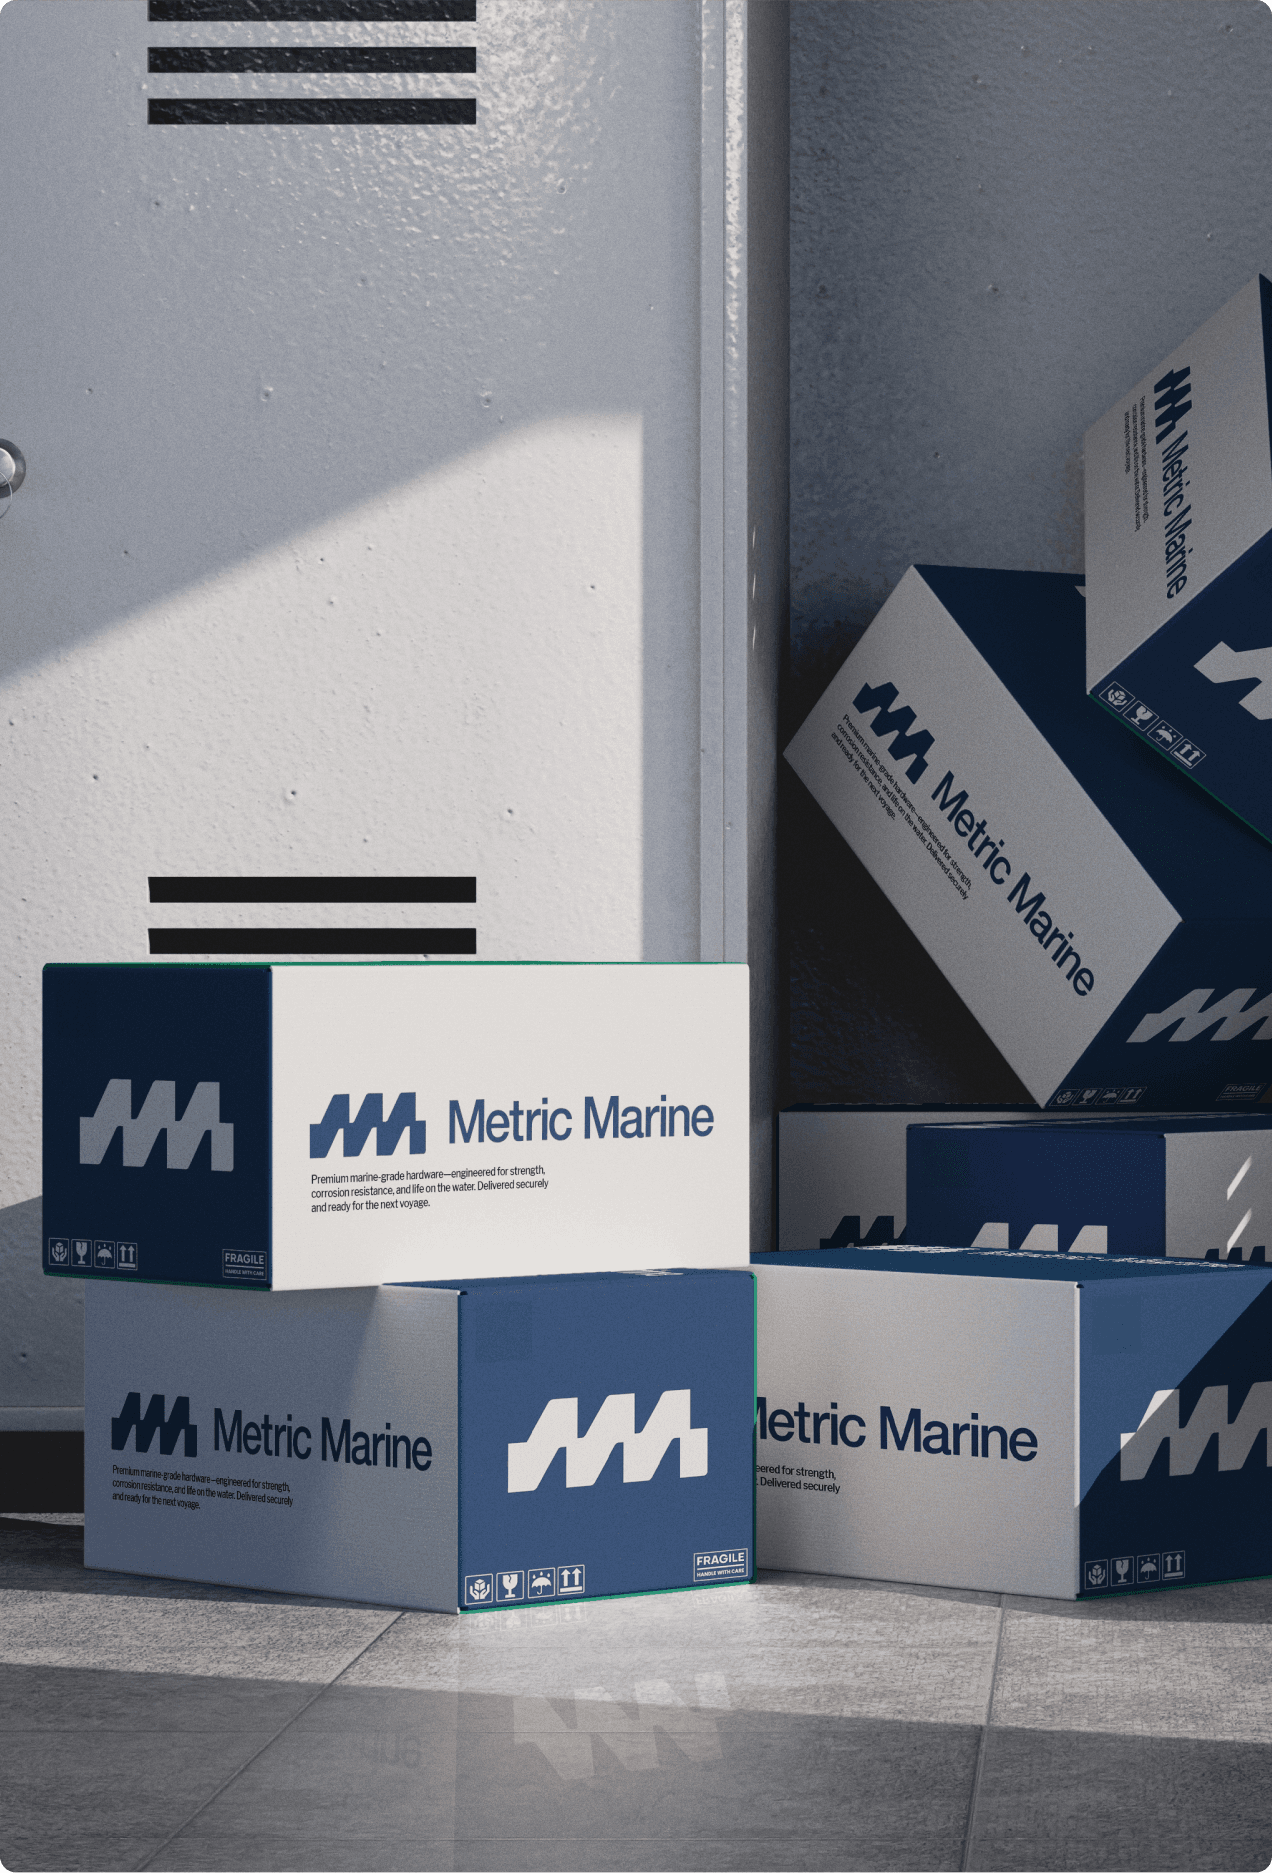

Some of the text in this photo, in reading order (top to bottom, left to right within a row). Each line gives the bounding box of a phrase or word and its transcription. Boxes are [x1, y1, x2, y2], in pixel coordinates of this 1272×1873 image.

[1162, 430, 1194, 599] Metric Marine
[931, 770, 1095, 997] Metric Marine
[449, 1094, 714, 1144] Metric Marine
[311, 1174, 349, 1185] Premium
[350, 1171, 405, 1184] marine-grade
[496, 1166, 509, 1176] for
[509, 1165, 546, 1178] strength,
[311, 1178, 549, 1199] corrosion resistance, and life on the water. Delivered securely
[311, 1199, 431, 1213] and ready for the next voyage.
[225, 1253, 265, 1264] FRAGILE
[757, 1397, 1038, 1462] etric Marine
[214, 1408, 433, 1472] Metric Marine
[112, 1464, 140, 1477] Premium
[251, 1478, 262, 1489] for
[261, 1480, 291, 1493] strength,
[781, 1465, 795, 1475] for
[795, 1467, 837, 1480] strength,
[112, 1480, 294, 1508] corrosion resistance, and life on the water. Delivered securely
[760, 1476, 841, 1494] Delivered securely
[112, 1492, 201, 1511] and ready for the next voyage.
[696, 1552, 745, 1566] FRAGILE
[696, 1570, 717, 1578] HANDLE
